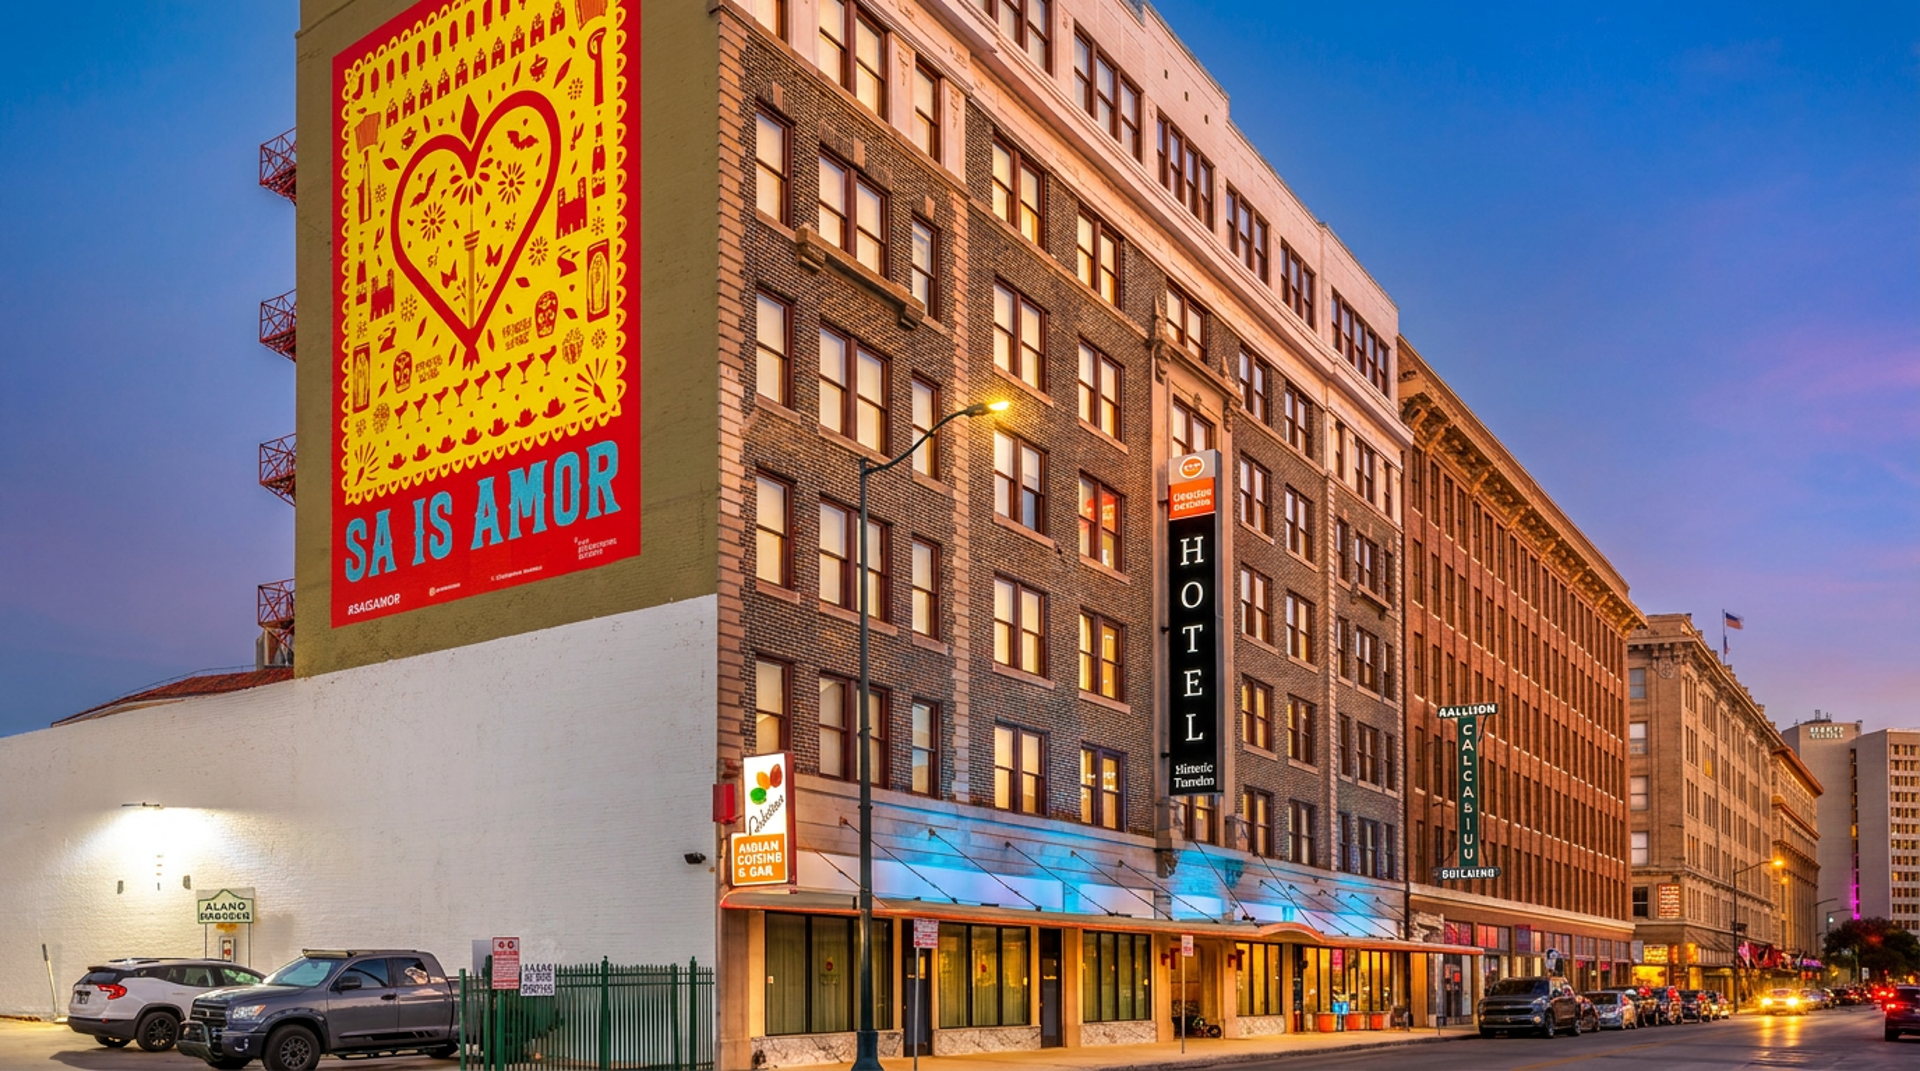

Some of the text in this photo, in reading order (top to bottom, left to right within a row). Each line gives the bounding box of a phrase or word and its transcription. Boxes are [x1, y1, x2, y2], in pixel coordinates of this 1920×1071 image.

[345, 440, 621, 582] SA IS AMOR
[1180, 536, 1204, 741] HOTEL
